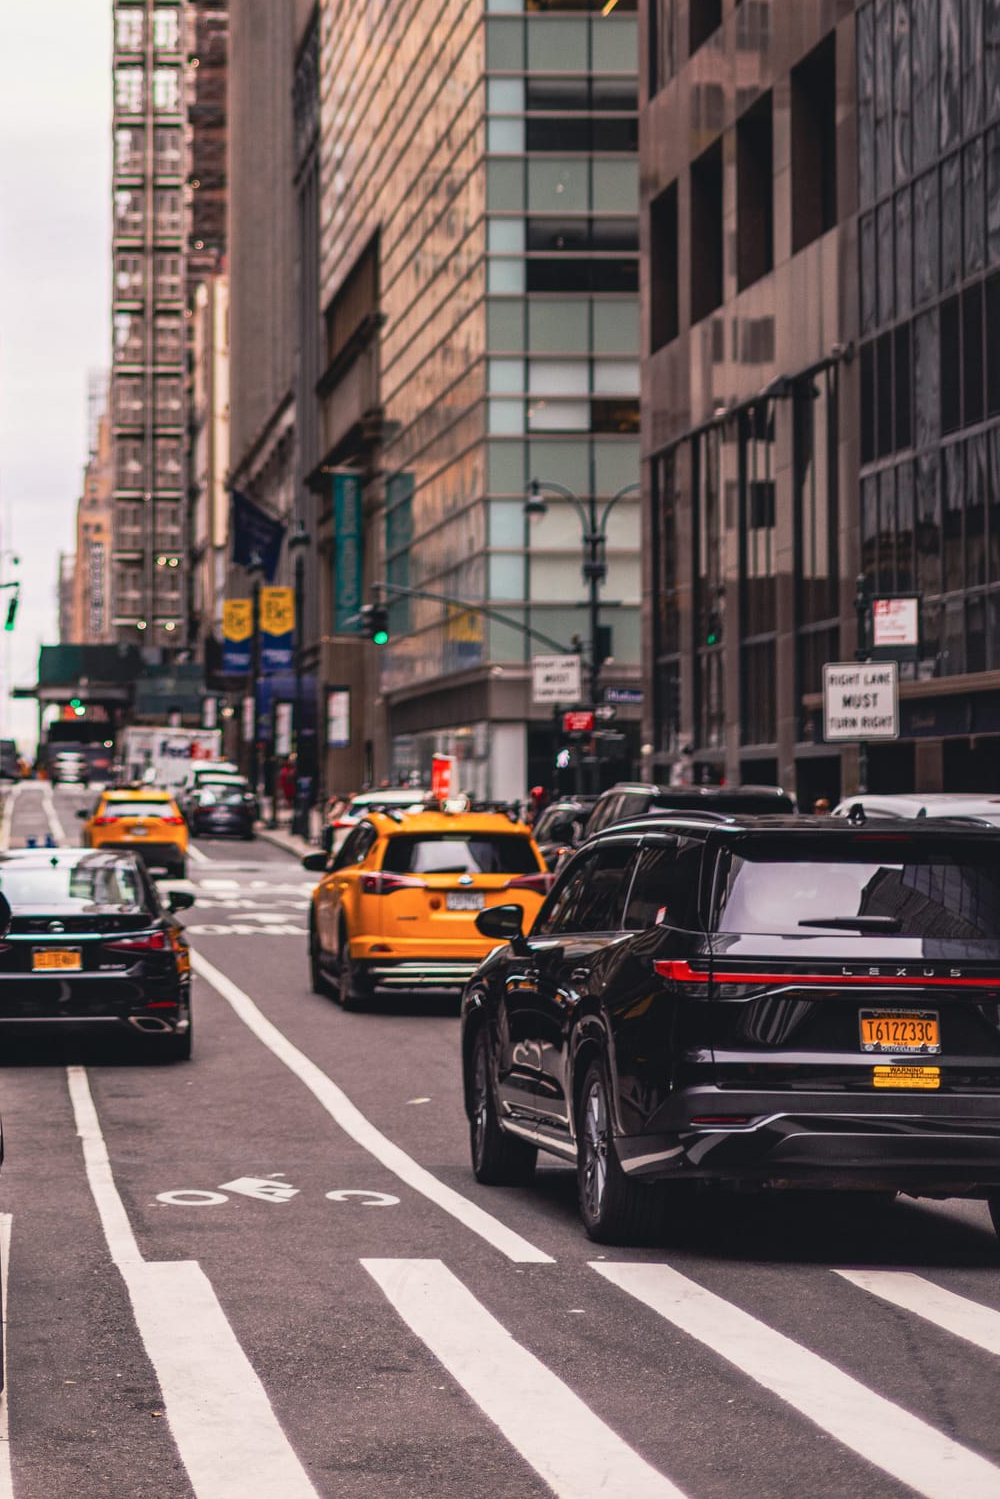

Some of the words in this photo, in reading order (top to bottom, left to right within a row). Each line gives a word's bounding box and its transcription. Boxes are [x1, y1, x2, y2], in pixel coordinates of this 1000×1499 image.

[829, 673, 860, 686] RIGHT
[863, 672, 891, 686] LANE
[842, 693, 879, 709] MUST
[829, 717, 858, 729] TURN
[861, 716, 893, 729] RIGHT
[842, 967, 961, 977] LEXUS
[867, 1021, 933, 1042] T612233C
